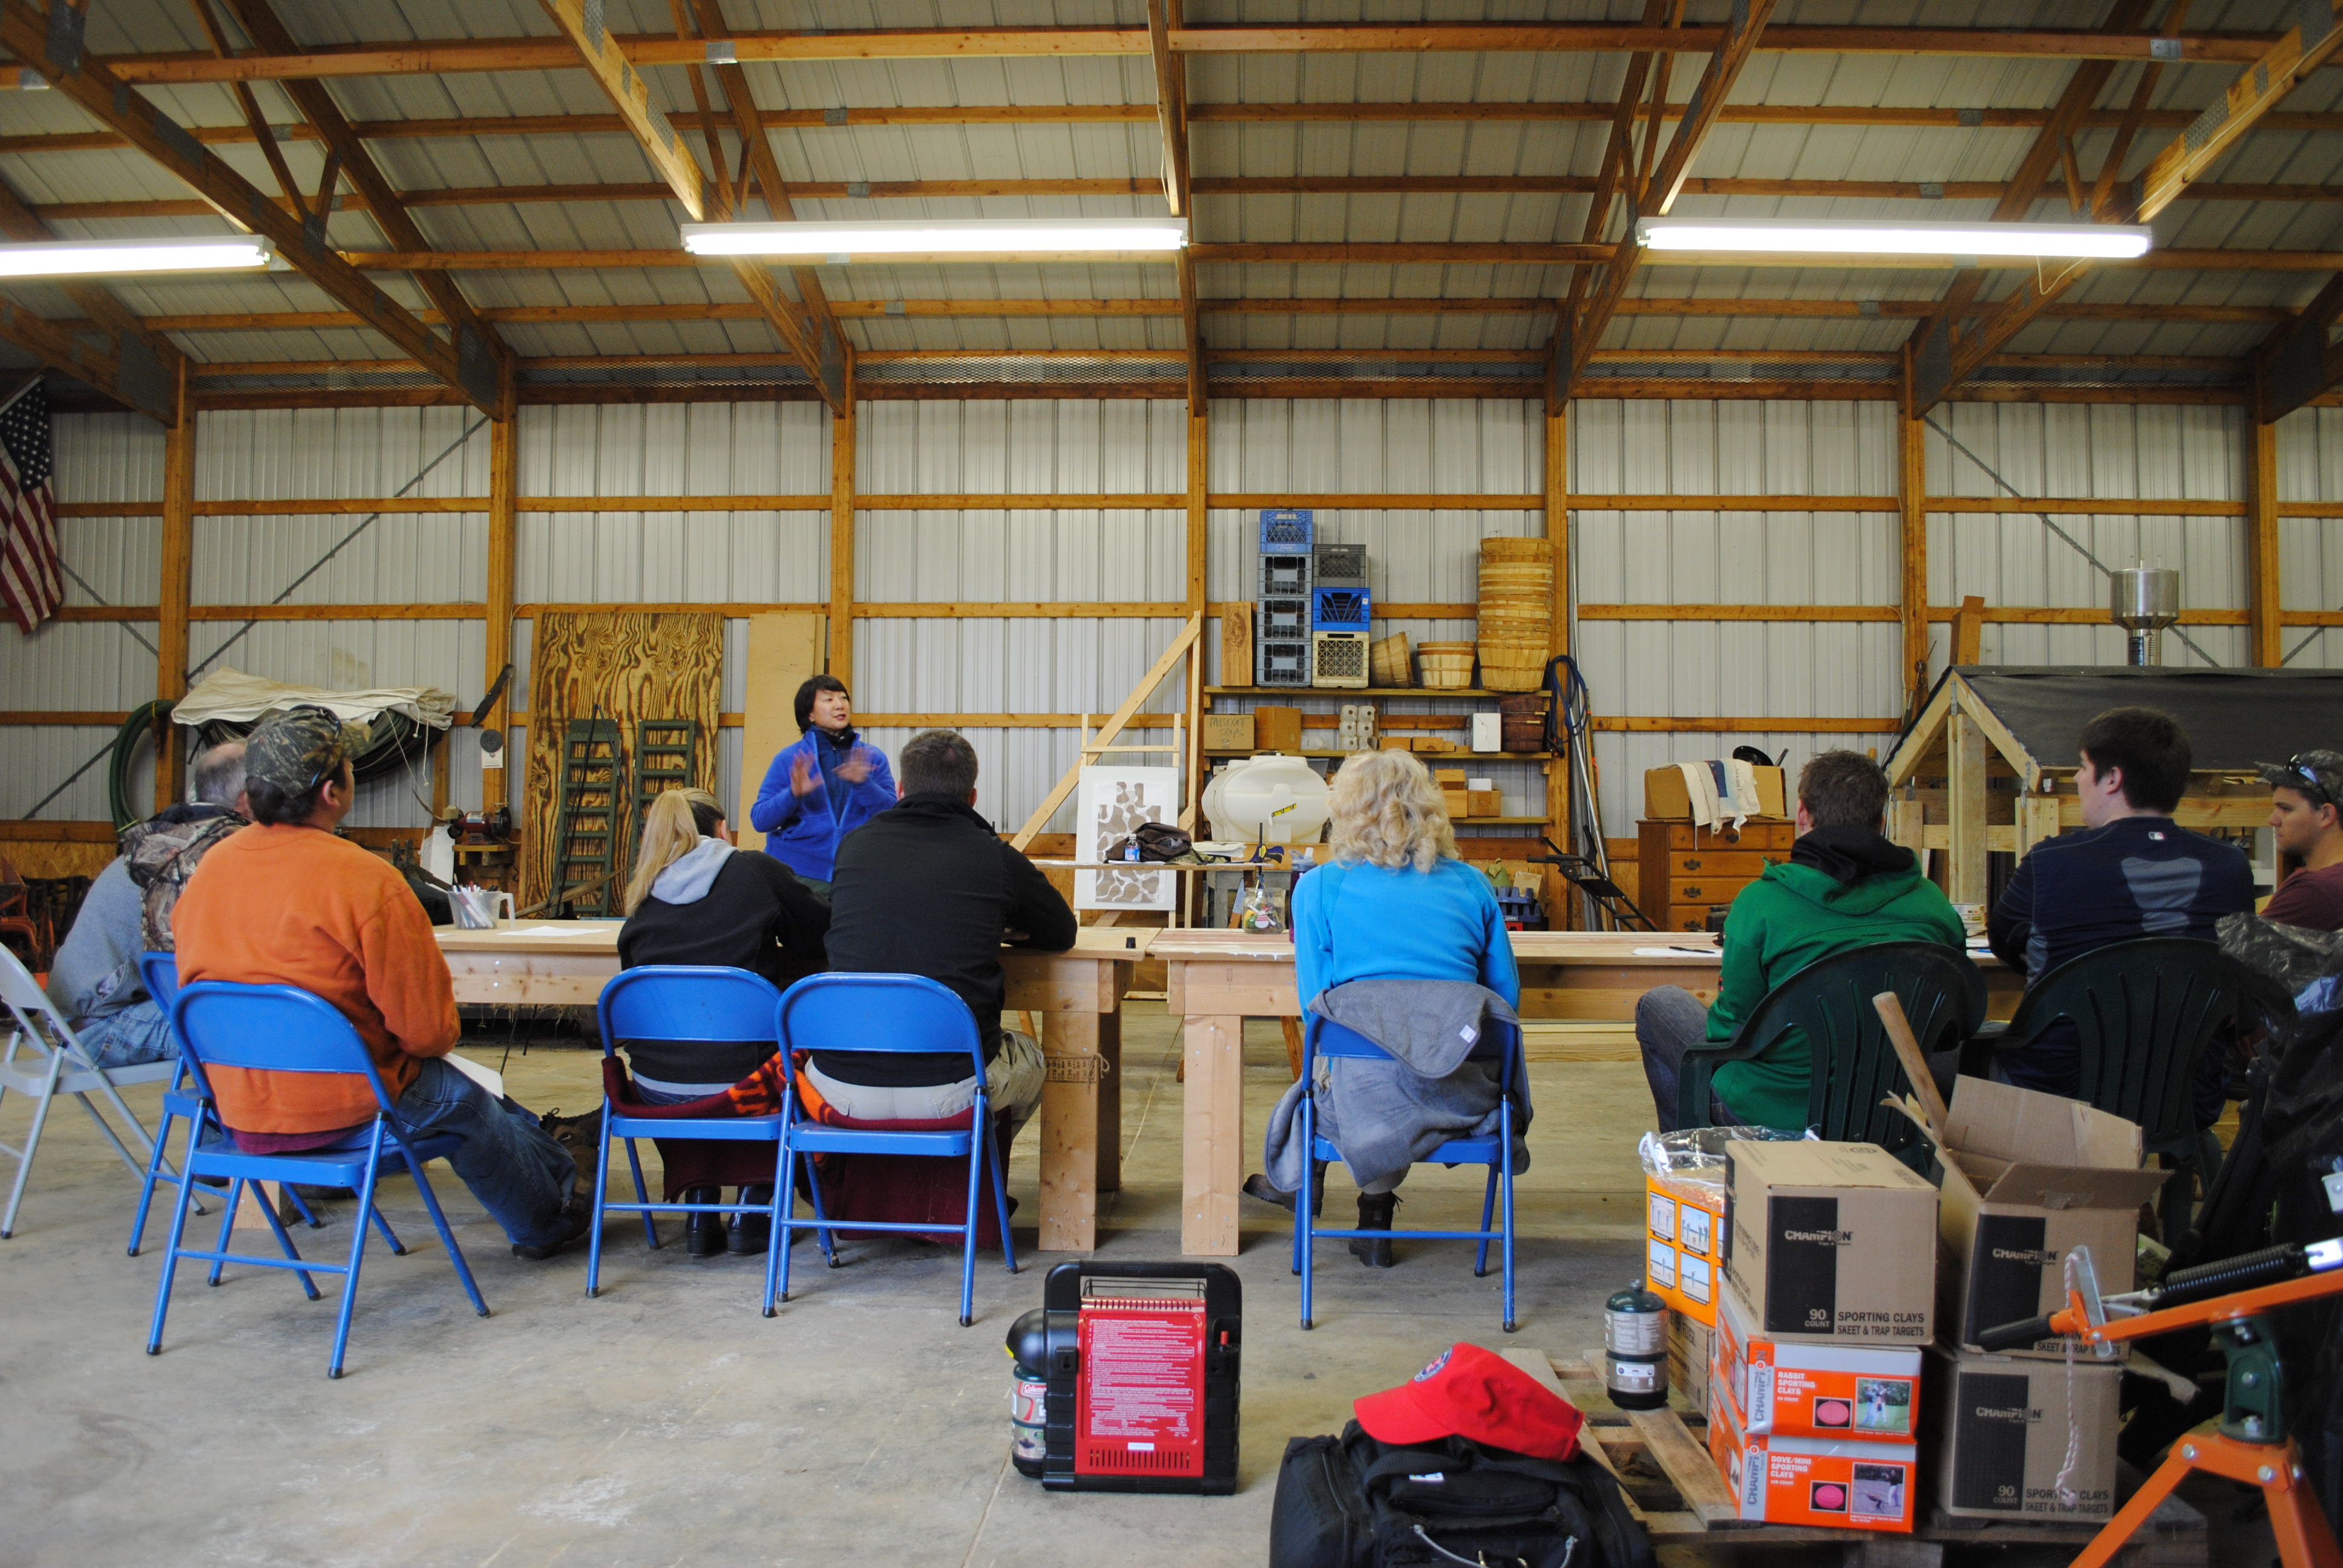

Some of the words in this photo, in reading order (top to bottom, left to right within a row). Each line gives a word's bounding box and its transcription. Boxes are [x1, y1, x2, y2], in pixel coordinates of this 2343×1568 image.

[1210, 717, 1250, 727] MUSKRAT
[1219, 728, 1244, 739] TRAPS
[1784, 1230, 1852, 1241] CHAMPION
[1992, 1248, 2057, 1260] CHAMPION
[1809, 1308, 1826, 1320] 90
[1838, 1312, 1889, 1322] SPORTING
[1893, 1313, 1924, 1323] CLAYS
[1837, 1325, 1861, 1334] SKEET
[1863, 1325, 1869, 1335] &
[1871, 1325, 1890, 1335] TRAP
[1892, 1326, 1924, 1336] TARGETS
[2036, 1342, 2059, 1352] SKEET
[1778, 1371, 1805, 1379] RABBIT
[1754, 1350, 1767, 1422] CHAMPION
[1778, 1379, 1815, 1388] SPORTING
[1976, 1407, 2041, 1419] CHAMPION
[1771, 1455, 1811, 1465] DOVE/MINI
[1747, 1435, 1761, 1505] CHAMPION
[1771, 1463, 1808, 1472] SPORTING
[1771, 1470, 1794, 1478] CLAYS
[1997, 1485, 2014, 1497] 90
[2079, 1489, 2108, 1500] CLAYS
[2025, 1501, 2048, 1512] SKEET
[2050, 1503, 2055, 1512] &
[2079, 1503, 2108, 1514] TARGETS
